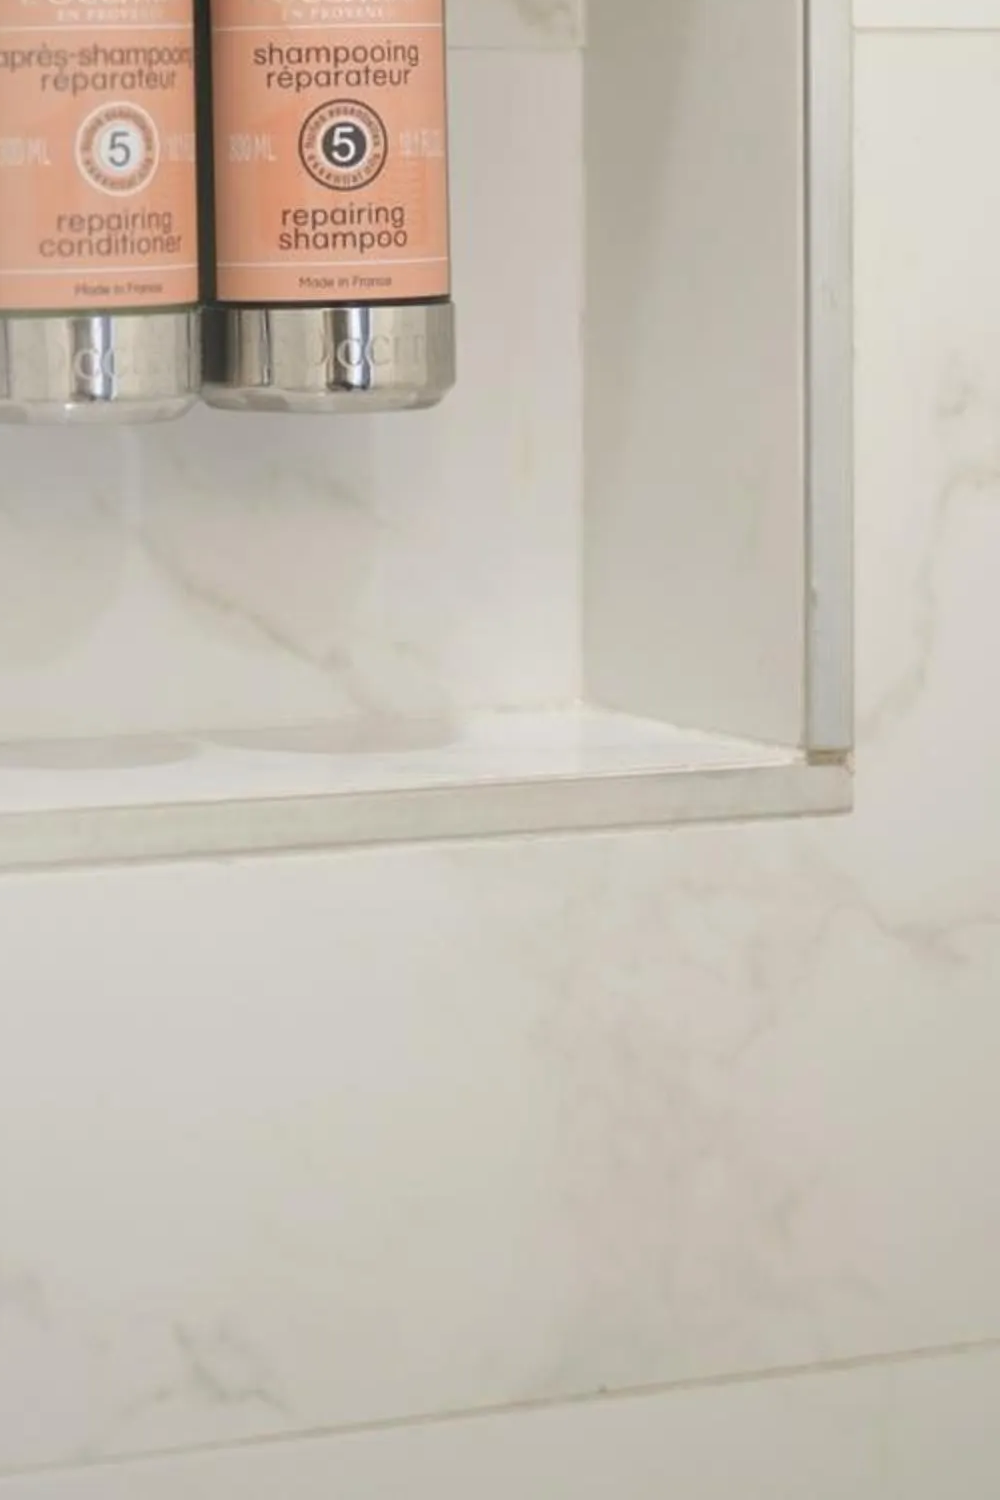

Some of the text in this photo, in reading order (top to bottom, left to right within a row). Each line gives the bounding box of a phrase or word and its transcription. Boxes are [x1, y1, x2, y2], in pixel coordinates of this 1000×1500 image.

[253, 40, 420, 69] shampooing
[40, 67, 176, 99] réparateur
[266, 65, 411, 93] réparateur
[108, 131, 131, 167] 5
[331, 126, 356, 163] 5
[56, 207, 173, 236] repairing
[281, 202, 406, 231] repairing
[38, 230, 184, 258] conditioner
[278, 228, 408, 254] shampoo
[73, 282, 112, 297] Made
[127, 281, 165, 295] France
[298, 273, 393, 289] Made in France
